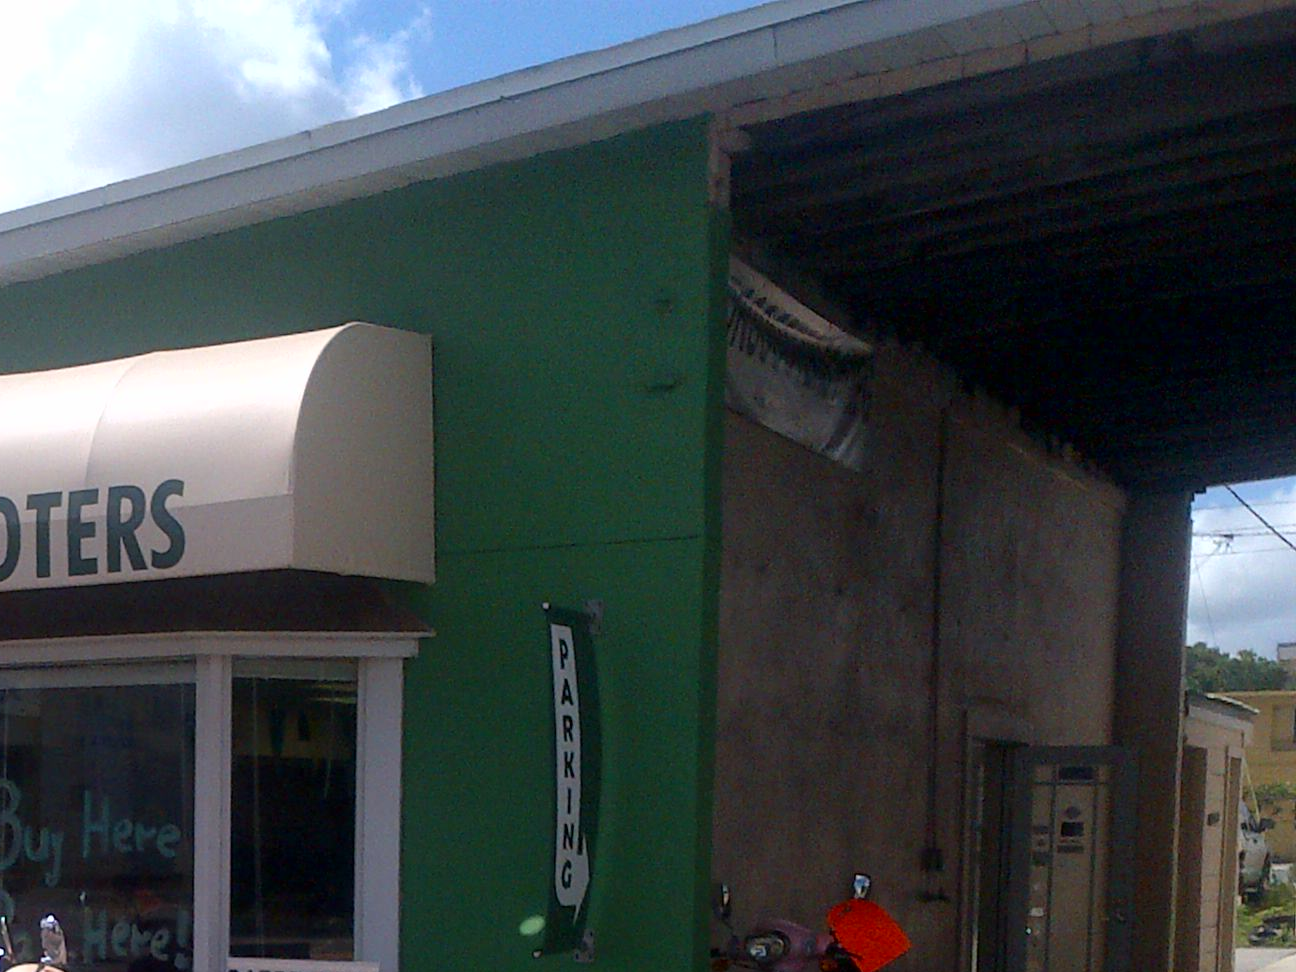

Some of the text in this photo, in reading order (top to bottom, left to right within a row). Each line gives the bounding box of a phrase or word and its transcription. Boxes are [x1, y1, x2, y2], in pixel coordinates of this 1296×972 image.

[559, 638, 575, 890] PARKING
[83, 790, 181, 859] Here
[83, 905, 190, 970] Here!
